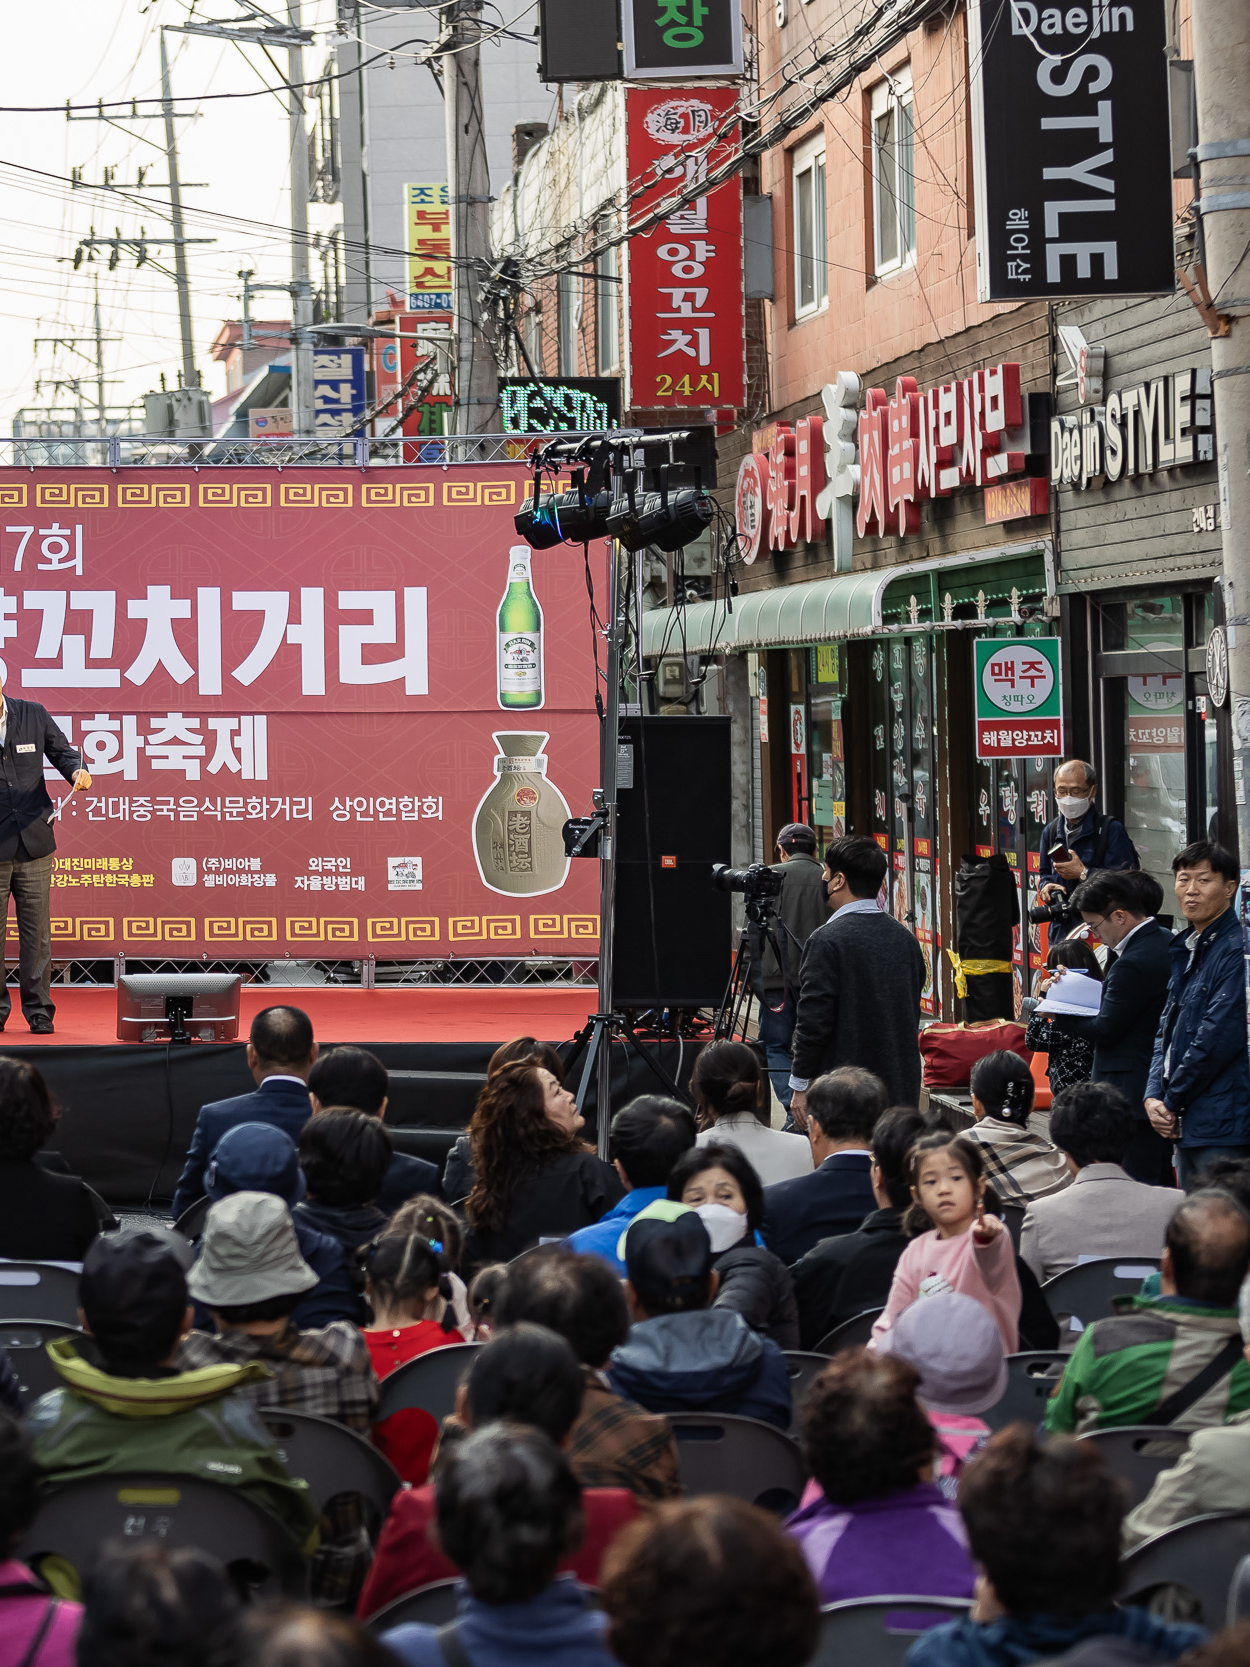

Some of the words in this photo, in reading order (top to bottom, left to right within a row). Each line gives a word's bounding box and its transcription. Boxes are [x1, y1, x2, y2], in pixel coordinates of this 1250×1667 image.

[1011, 0, 1135, 39] Daejin
[1036, 53, 1119, 283] STYLE
[1005, 207, 1032, 282] 헤어샵
[655, 371, 721, 398] 24시
[918, 362, 1006, 499] 샤브샤브
[1051, 406, 1100, 491] Daejin
[1105, 371, 1194, 482] STYLE
[990, 660, 1047, 689] 맥주
[1001, 694, 1037, 707] 칭따오
[982, 729, 1059, 748] 해월양꼬치
[85, 795, 313, 822] 건대중국음식문화거리
[329, 795, 444, 822] 상인연합회
[51, 857, 134, 871] )대진미래통상
[202, 857, 262, 871] (주)비아블
[308, 857, 352, 872] 외국인
[202, 873, 278, 888] 셀비아화장품
[294, 875, 366, 892] 자율방범대
